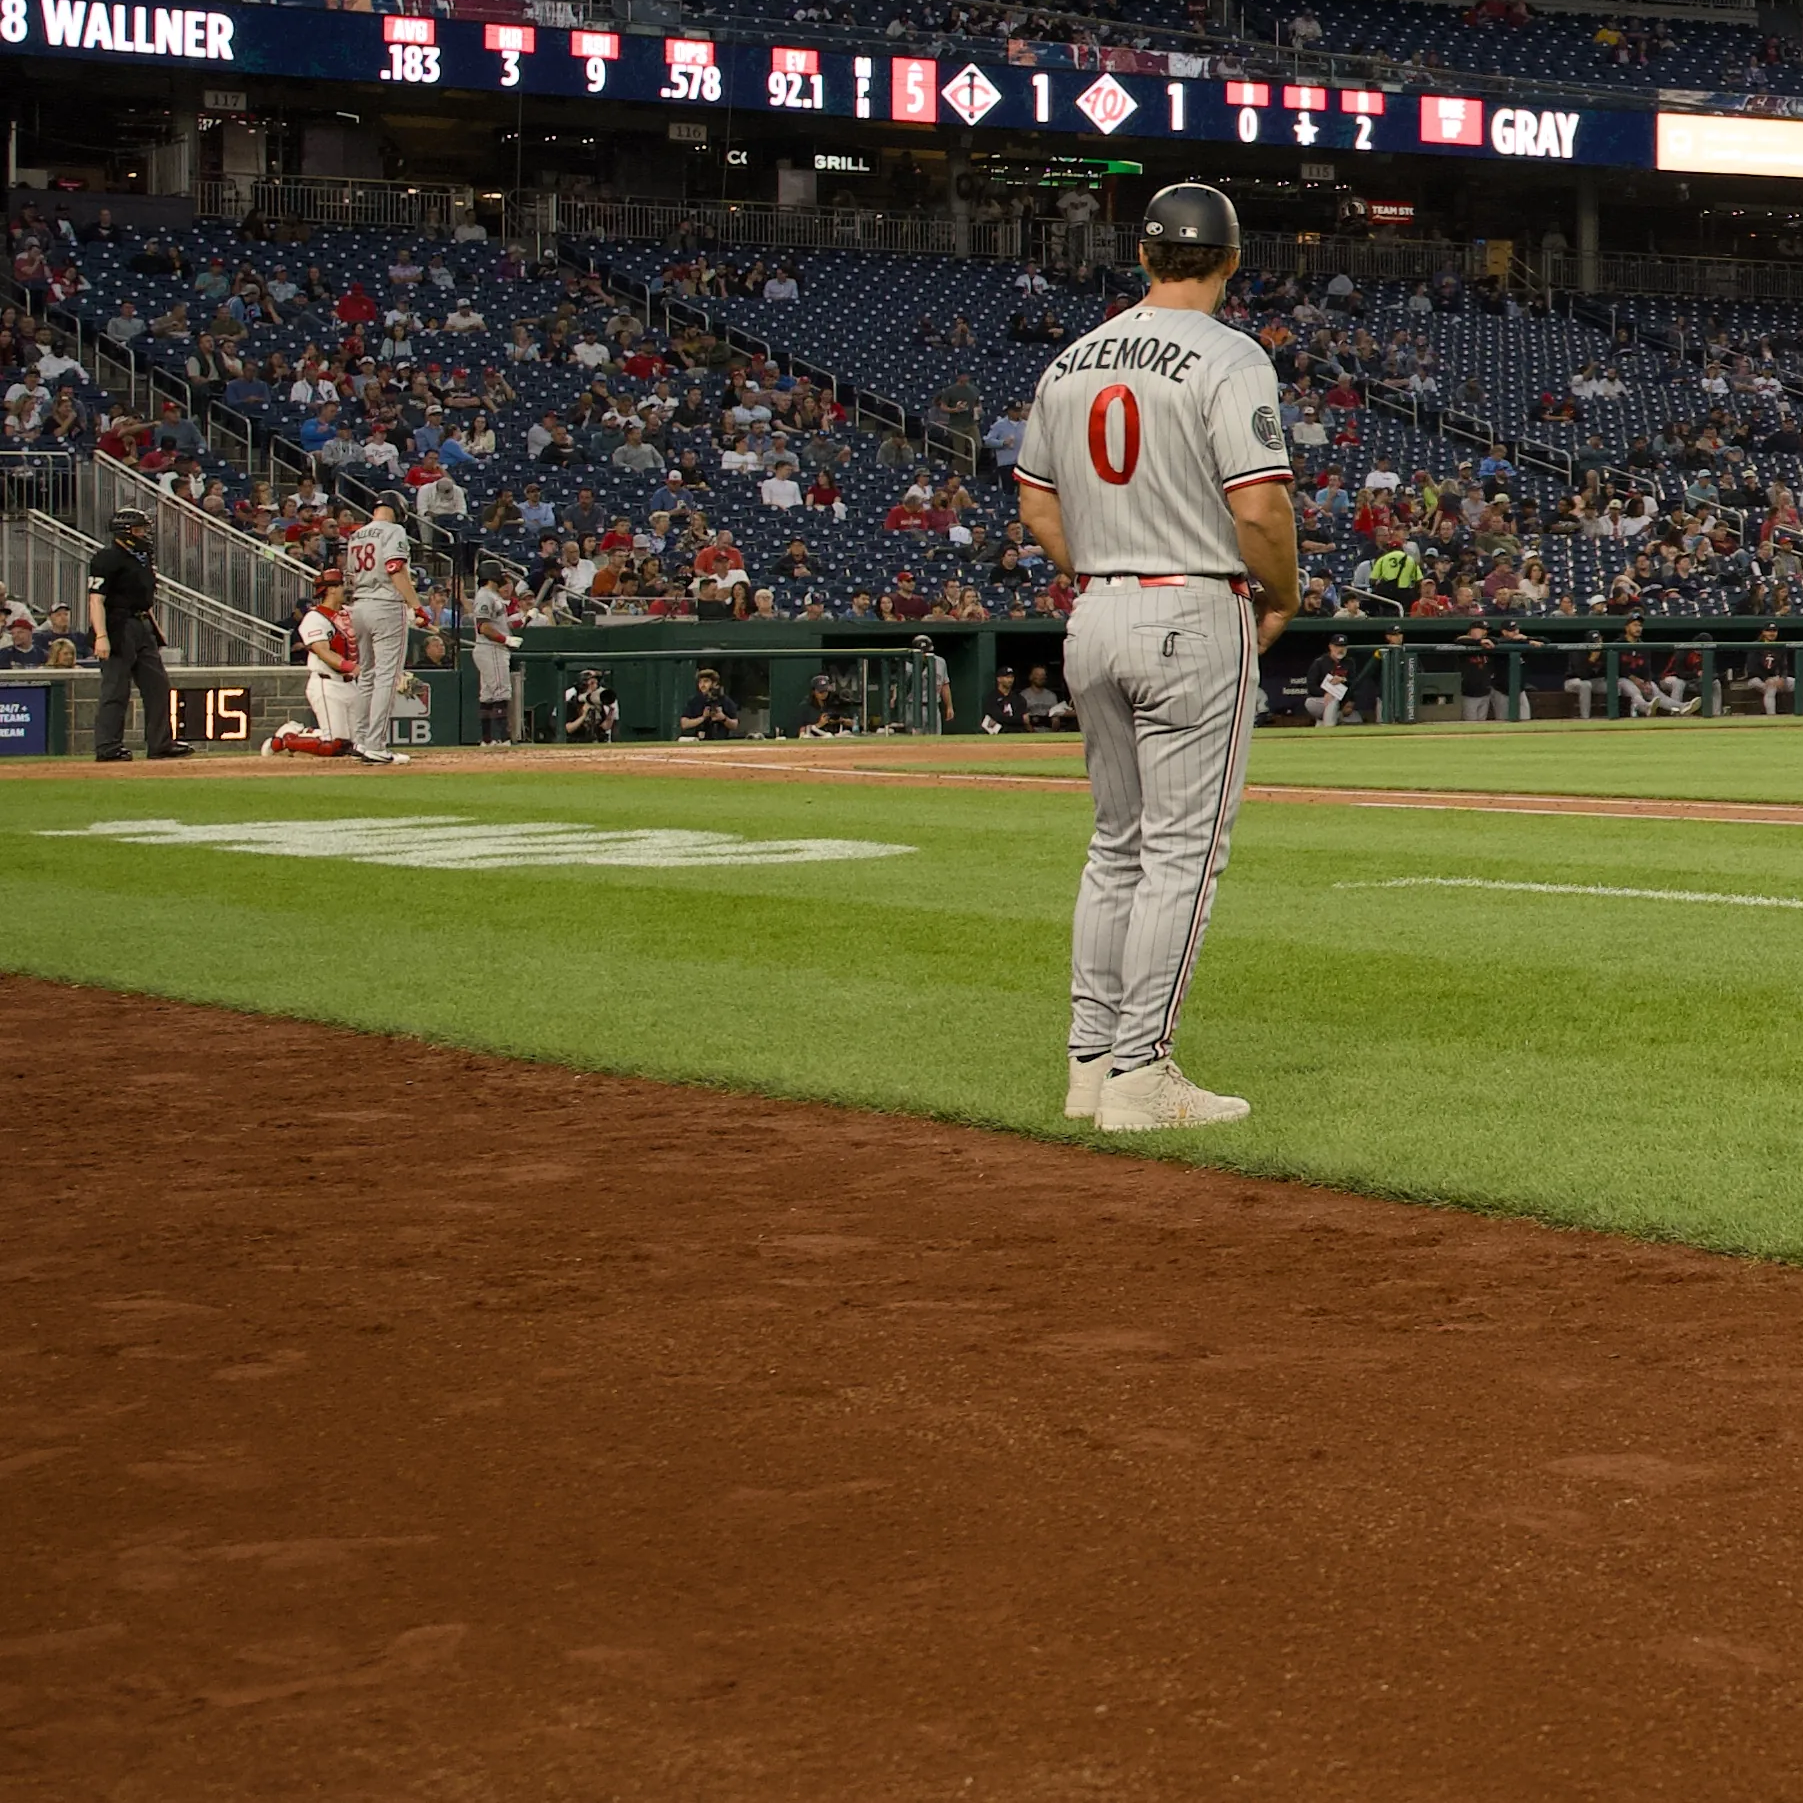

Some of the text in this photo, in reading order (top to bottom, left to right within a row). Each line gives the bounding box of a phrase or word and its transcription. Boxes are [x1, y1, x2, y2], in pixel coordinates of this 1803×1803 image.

[393, 20, 427, 42] AVG
[380, 44, 440, 84] .183
[500, 50, 520, 87] 3
[587, 57, 606, 93] 9
[214, 94, 240, 107] 117
[660, 64, 722, 102] .578
[768, 71, 824, 109] 92.1
[907, 72, 924, 113] 5
[1032, 74, 1051, 122] 1
[1168, 83, 1185, 131] 1
[1240, 108, 1257, 143] 0
[1356, 115, 1372, 150] 2
[1490, 107, 1580, 159] GRAY
[815, 154, 870, 172] GRILL
[1372, 205, 1397, 215] TEAM
[1053, 337, 1202, 384] SIZEMORE
[1088, 383, 1141, 485] 0
[351, 542, 376, 573] 38
